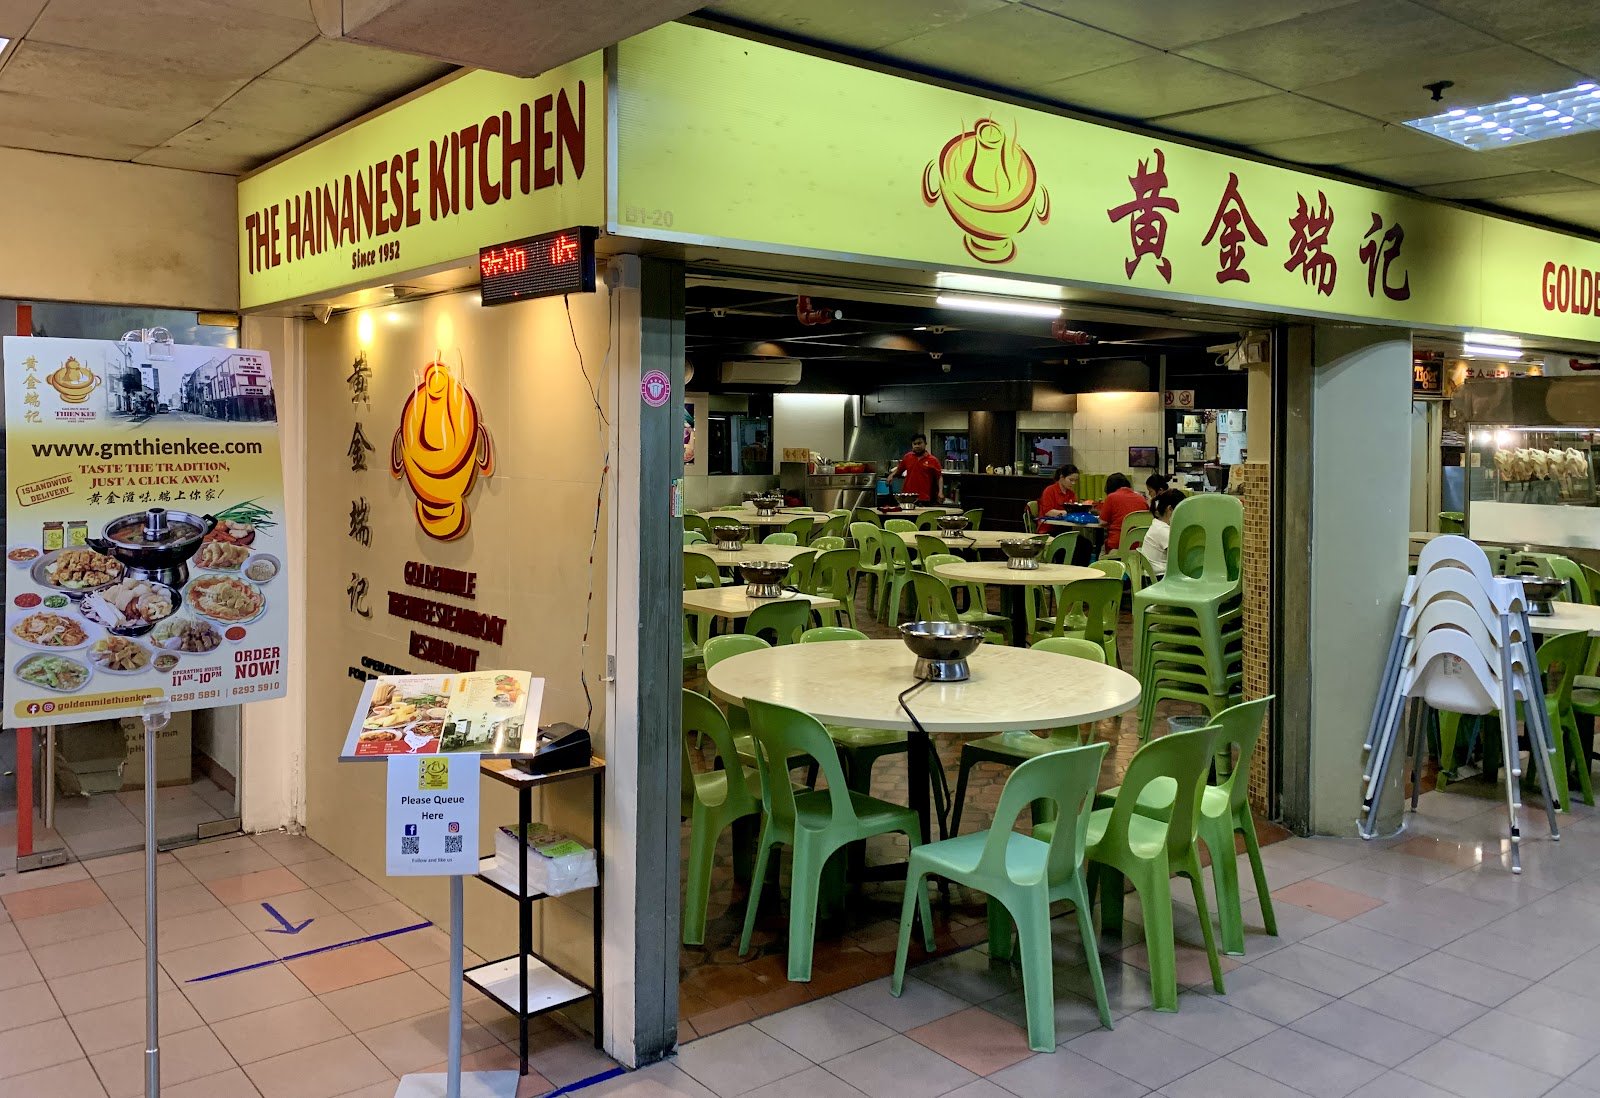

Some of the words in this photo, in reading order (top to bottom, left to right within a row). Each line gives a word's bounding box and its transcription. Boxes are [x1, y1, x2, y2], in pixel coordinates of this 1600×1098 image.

[246, 203, 280, 275] THE
[286, 147, 421, 263] HAINANESE
[429, 80, 586, 221] KITCHEN
[1106, 147, 1411, 302] 黄金端记
[378, 240, 400, 263] 1952
[1541, 261, 1600, 317] GOLDE
[1414, 365, 1438, 389] Tiger
[22, 355, 42, 423] 黄金端记
[32, 438, 262, 460] www.gmthienkee.com
[78, 464, 122, 474] TASTE
[124, 463, 153, 473] THE
[155, 462, 230, 473] TRADITION,
[22, 476, 73, 495] ISLANDWIDE
[90, 477, 124, 489] JUST
[126, 476, 136, 486] A
[138, 476, 178, 485] CLICK
[181, 474, 220, 484] AWAY!
[30, 486, 70, 502] DELIVERY
[234, 646, 280, 663] ORDER
[172, 667, 202, 675] OPERATING
[235, 660, 280, 679] NOW!
[170, 692, 194, 702] 6298
[198, 689, 220, 699] 5891
[232, 685, 255, 695] 6293
[257, 682, 280, 692] 5910
[401, 796, 431, 805] Please
[434, 795, 465, 804] Queue
[421, 811, 444, 820] Here
